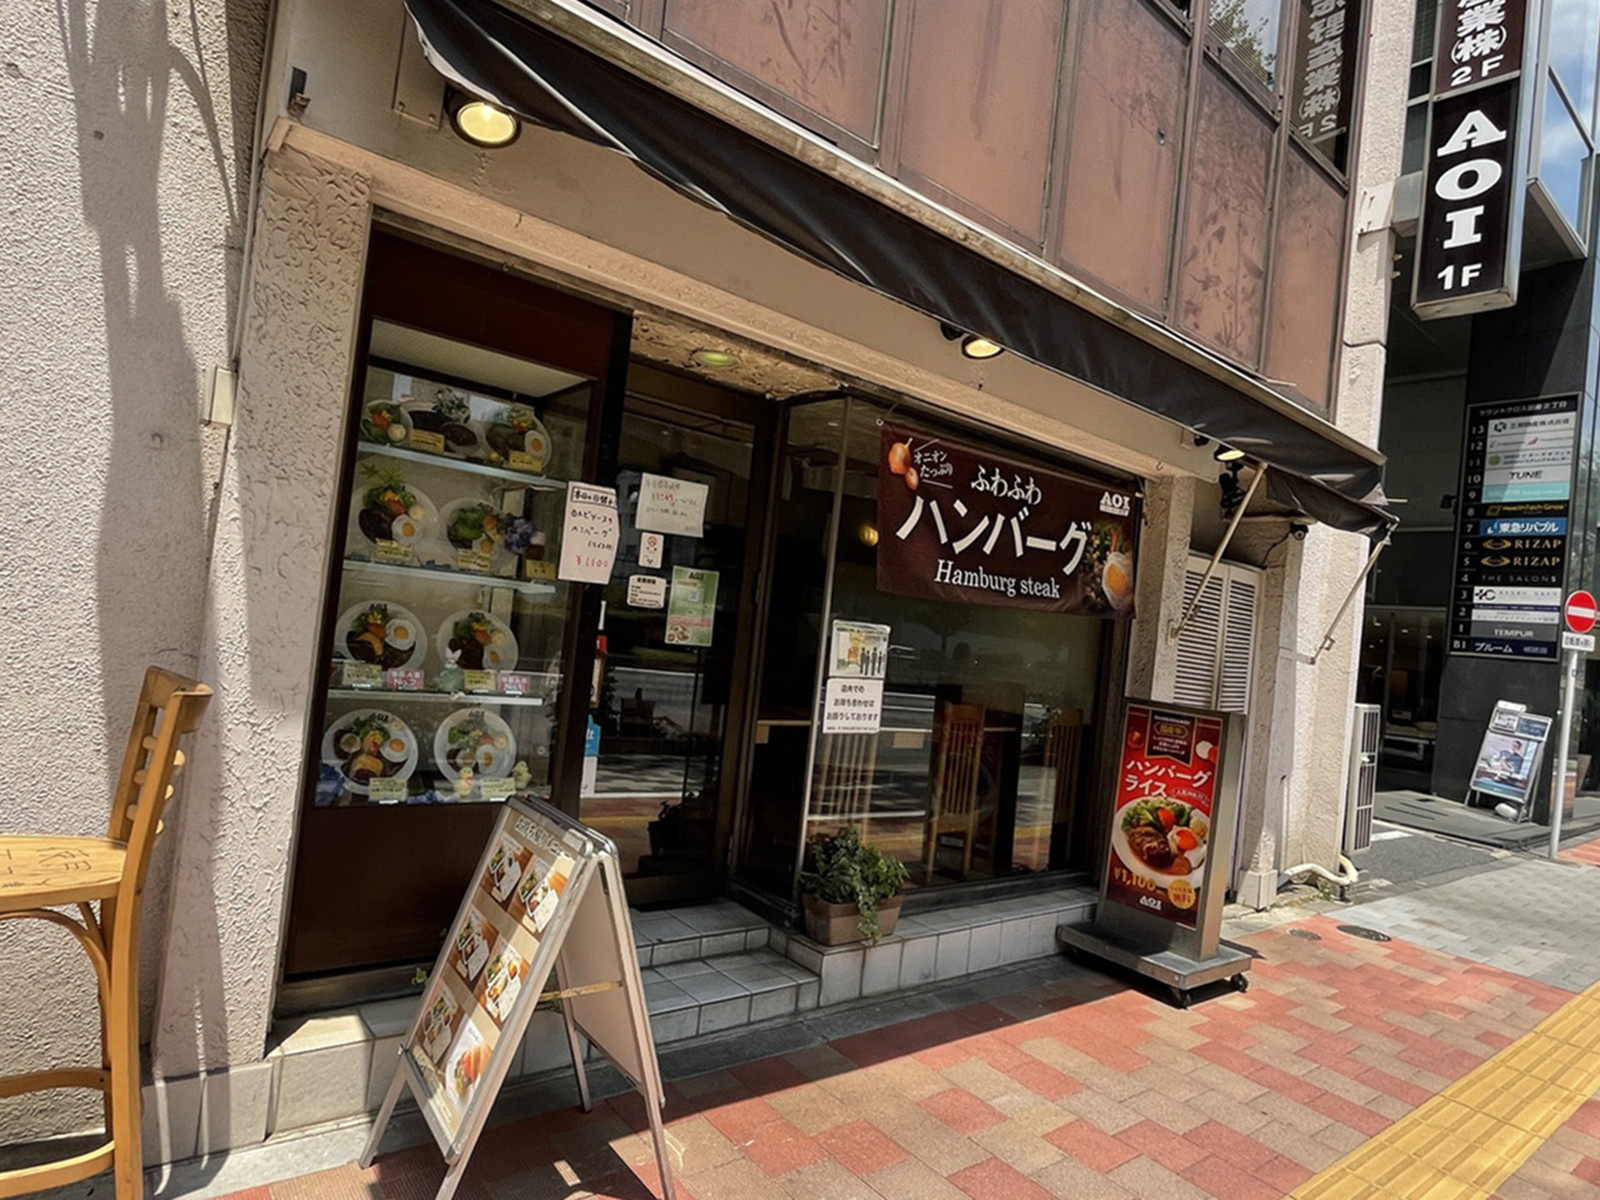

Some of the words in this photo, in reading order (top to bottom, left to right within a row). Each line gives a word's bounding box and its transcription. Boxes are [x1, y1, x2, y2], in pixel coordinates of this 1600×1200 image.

[1450, 54, 1504, 87] 2F
[1435, 109, 1506, 250] AOI
[1437, 263, 1482, 290] 1F
[1471, 441, 1483, 451] 12
[1468, 475, 1481, 484] 10
[1509, 470, 1544, 479] TUNE
[971, 464, 1042, 505] ふわふわ
[1100, 491, 1130, 510] AOI
[1469, 491, 1477, 499] 9
[1466, 524, 1473, 533] 7
[1499, 521, 1560, 534] 東急リバブル
[895, 495, 1092, 576] ハンバーグ
[1464, 541, 1472, 549] 6
[1515, 540, 1562, 549] RIZAP
[1464, 557, 1471, 566] 5
[1513, 557, 1560, 566] RIZAP
[934, 559, 1016, 597] Hamburg
[1020, 577, 1061, 599] steak
[1461, 574, 1469, 582] 4
[1509, 575, 1557, 583] SALONS
[1460, 591, 1467, 599] 3
[1459, 608, 1466, 616] 2
[1494, 629, 1534, 637] TEMPUR
[1453, 640, 1466, 649] B1
[1474, 643, 1513, 653] ブルーム
[1126, 760, 1212, 788] ハンバーグ
[1125, 774, 1167, 798] ライス
